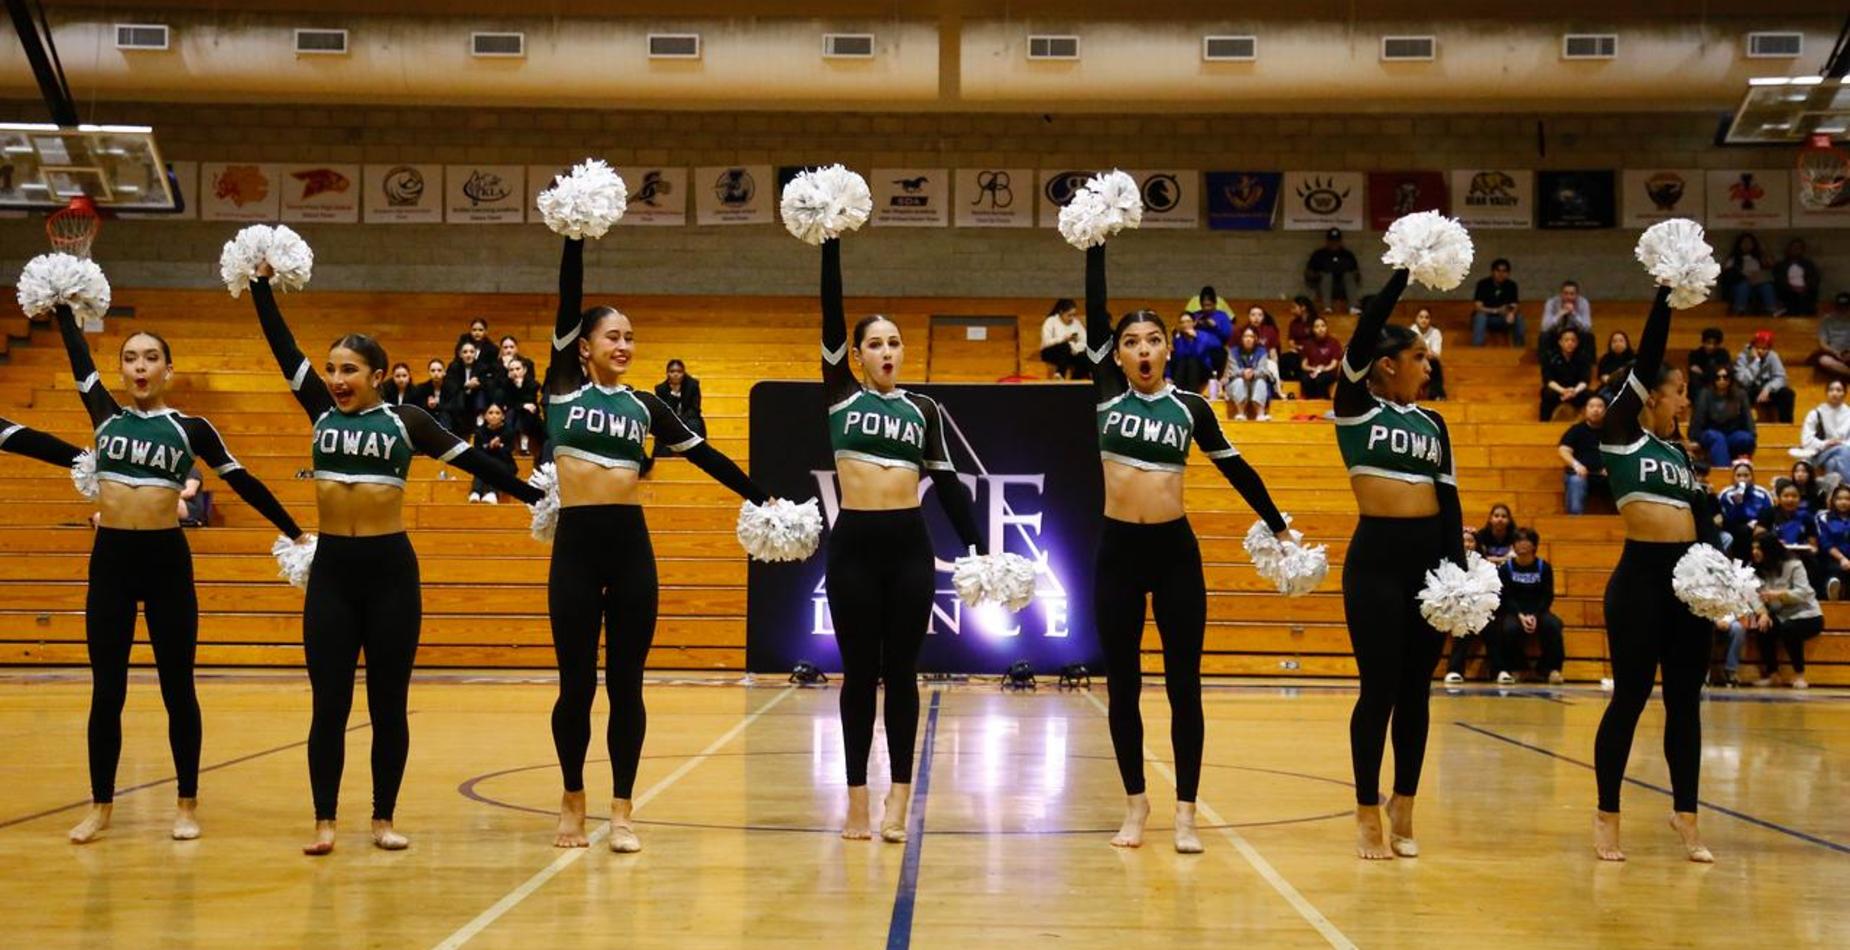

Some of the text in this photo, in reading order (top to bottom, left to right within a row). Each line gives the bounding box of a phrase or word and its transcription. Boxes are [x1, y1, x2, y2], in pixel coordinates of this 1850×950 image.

[1465, 195, 1519, 206] BEAR VALLEY
[564, 406, 647, 448] POWAY
[844, 411, 924, 450] POWAY
[1103, 411, 1188, 452] POWAY
[97, 435, 184, 473] POWAY
[1640, 458, 1691, 490] POW
